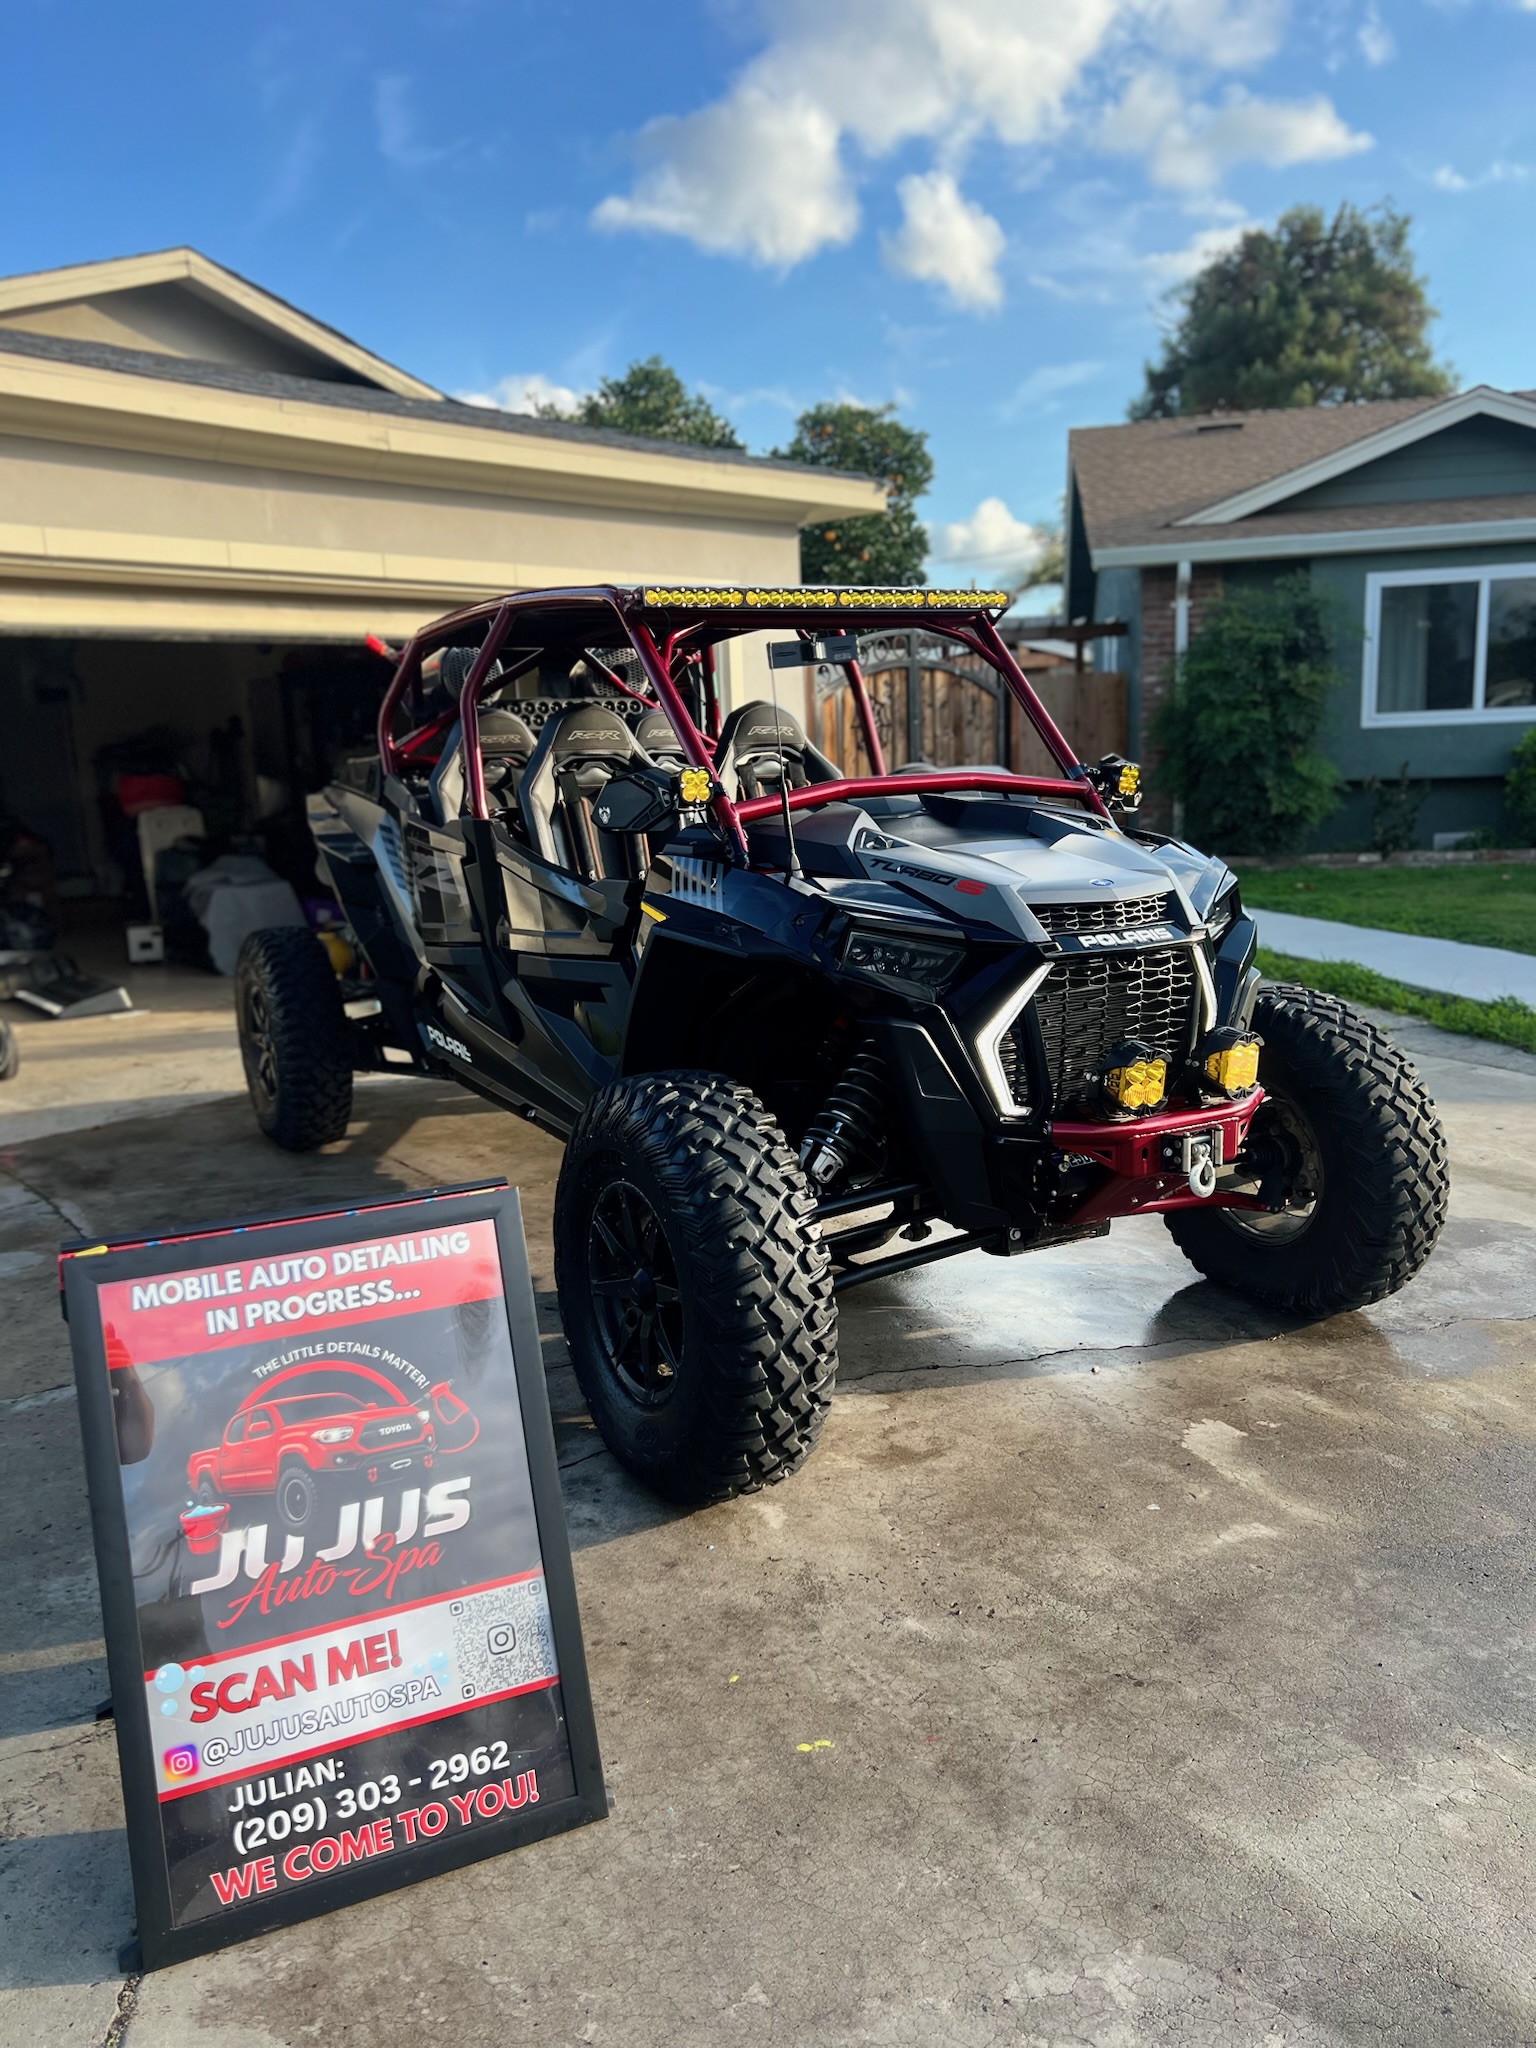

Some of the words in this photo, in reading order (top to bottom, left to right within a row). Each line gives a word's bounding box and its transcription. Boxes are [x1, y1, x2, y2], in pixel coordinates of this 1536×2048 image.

[567, 730, 620, 741] RZR
[869, 858, 958, 886] TURBO
[1078, 927, 1174, 948] POLARIS
[426, 1024, 472, 1063] POLARIS
[130, 1268, 243, 1312] MOBILE
[248, 1256, 327, 1292] AUTO
[331, 1231, 471, 1277] DETAILING
[205, 1308, 240, 1336] IN
[244, 1279, 422, 1328] PROGRESS...
[252, 1357, 282, 1379] THE
[280, 1343, 326, 1366] LITTLE
[327, 1341, 382, 1358] DETAILS
[382, 1349, 431, 1390] MATTER!
[378, 1422, 412, 1436] TOYOTA
[189, 1652, 318, 1724] SCAN
[326, 1628, 403, 1687] ME!
[201, 1675, 441, 1767] @JUJUSAUTOSPA
[227, 1758, 346, 1813] JULIAN:
[232, 1796, 328, 1855] (209)
[335, 1773, 402, 1819] 303
[407, 1776, 422, 1787] -
[428, 1739, 512, 1791] 2962
[210, 1855, 278, 1905] WE
[282, 1816, 395, 1881] COME
[397, 1801, 449, 1844] TO
[447, 1768, 540, 1826] YOU!
